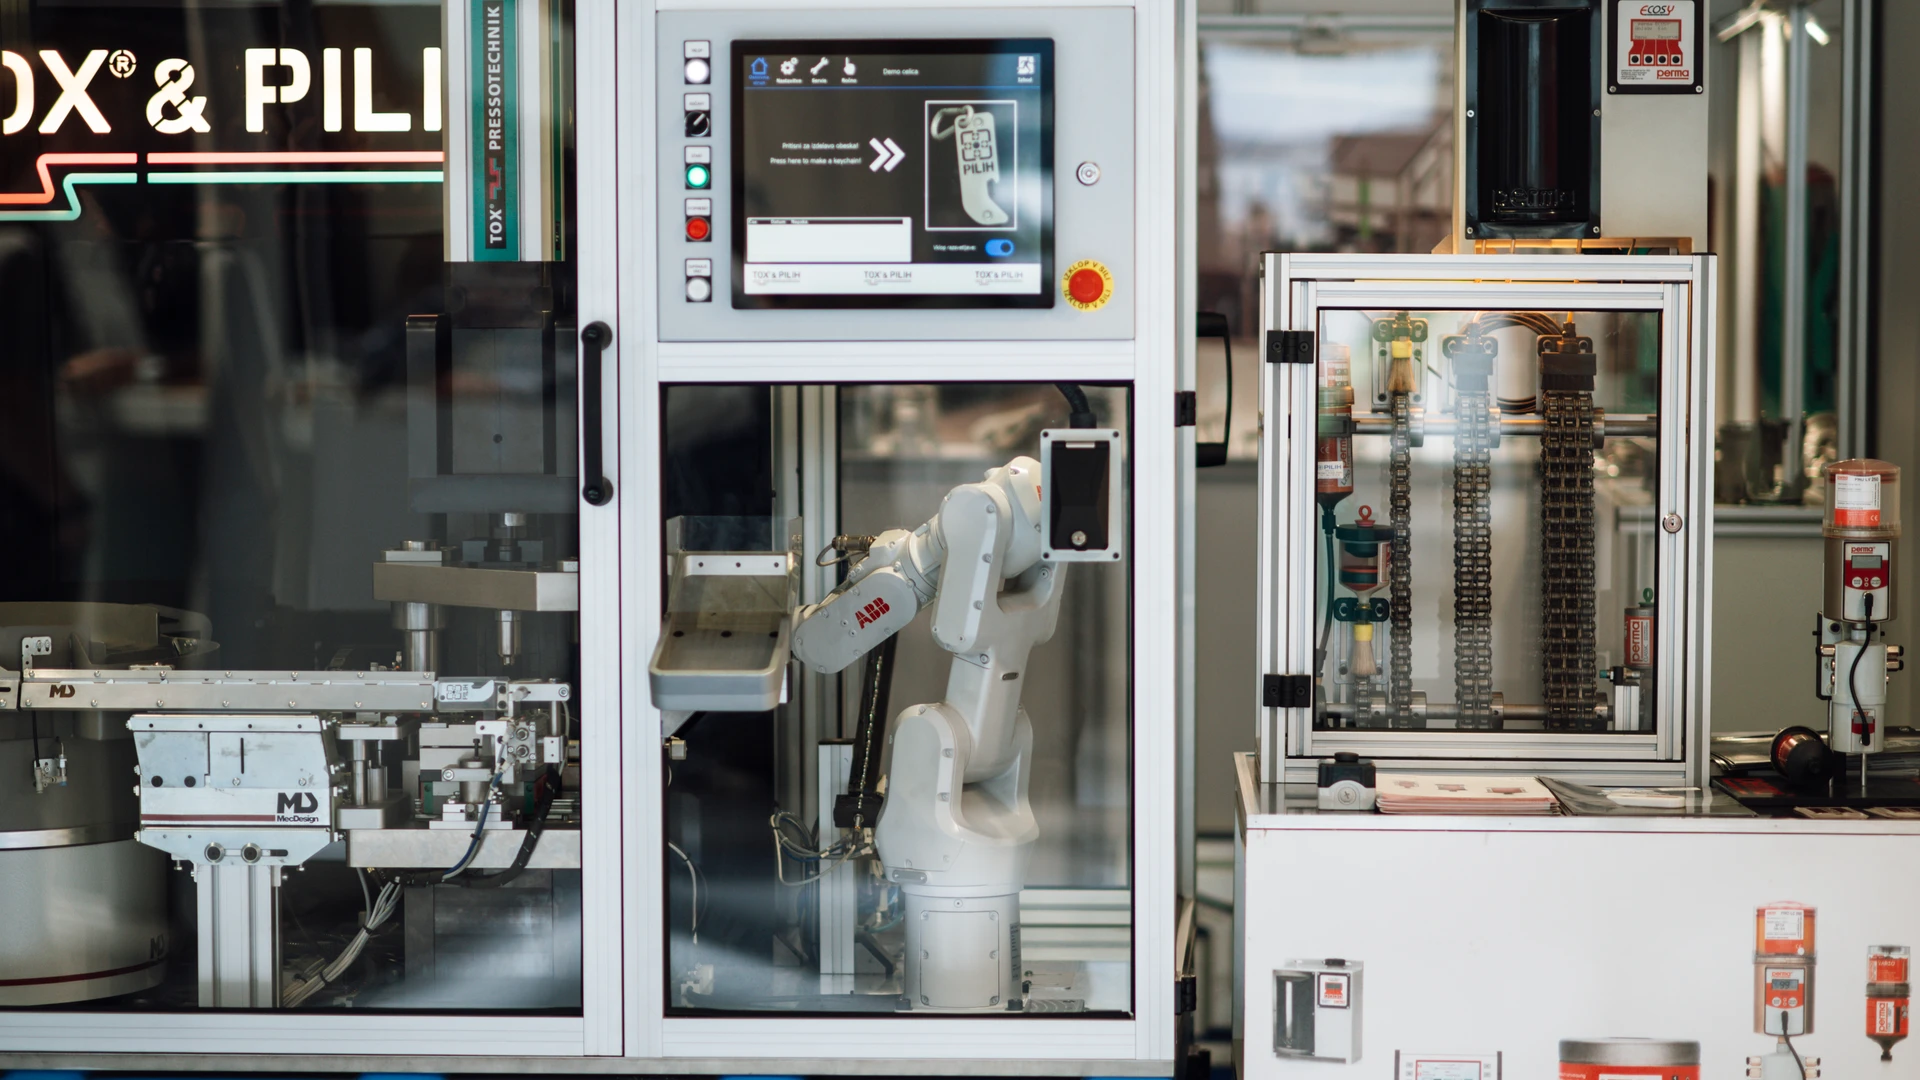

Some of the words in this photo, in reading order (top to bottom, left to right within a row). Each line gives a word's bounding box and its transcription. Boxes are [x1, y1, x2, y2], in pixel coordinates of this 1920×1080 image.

[487, 6, 501, 150] PRESSOTECHNIK
[1657, 70, 1689, 80] perma
[145, 58, 211, 135] &
[963, 162, 995, 175] PILIH
[1063, 260, 1090, 281] IZKLOP
[855, 597, 890, 629] ABB
[1632, 621, 1643, 662] perma
[277, 815, 319, 824] MecDesign
[1879, 1003, 1888, 1033] perma
